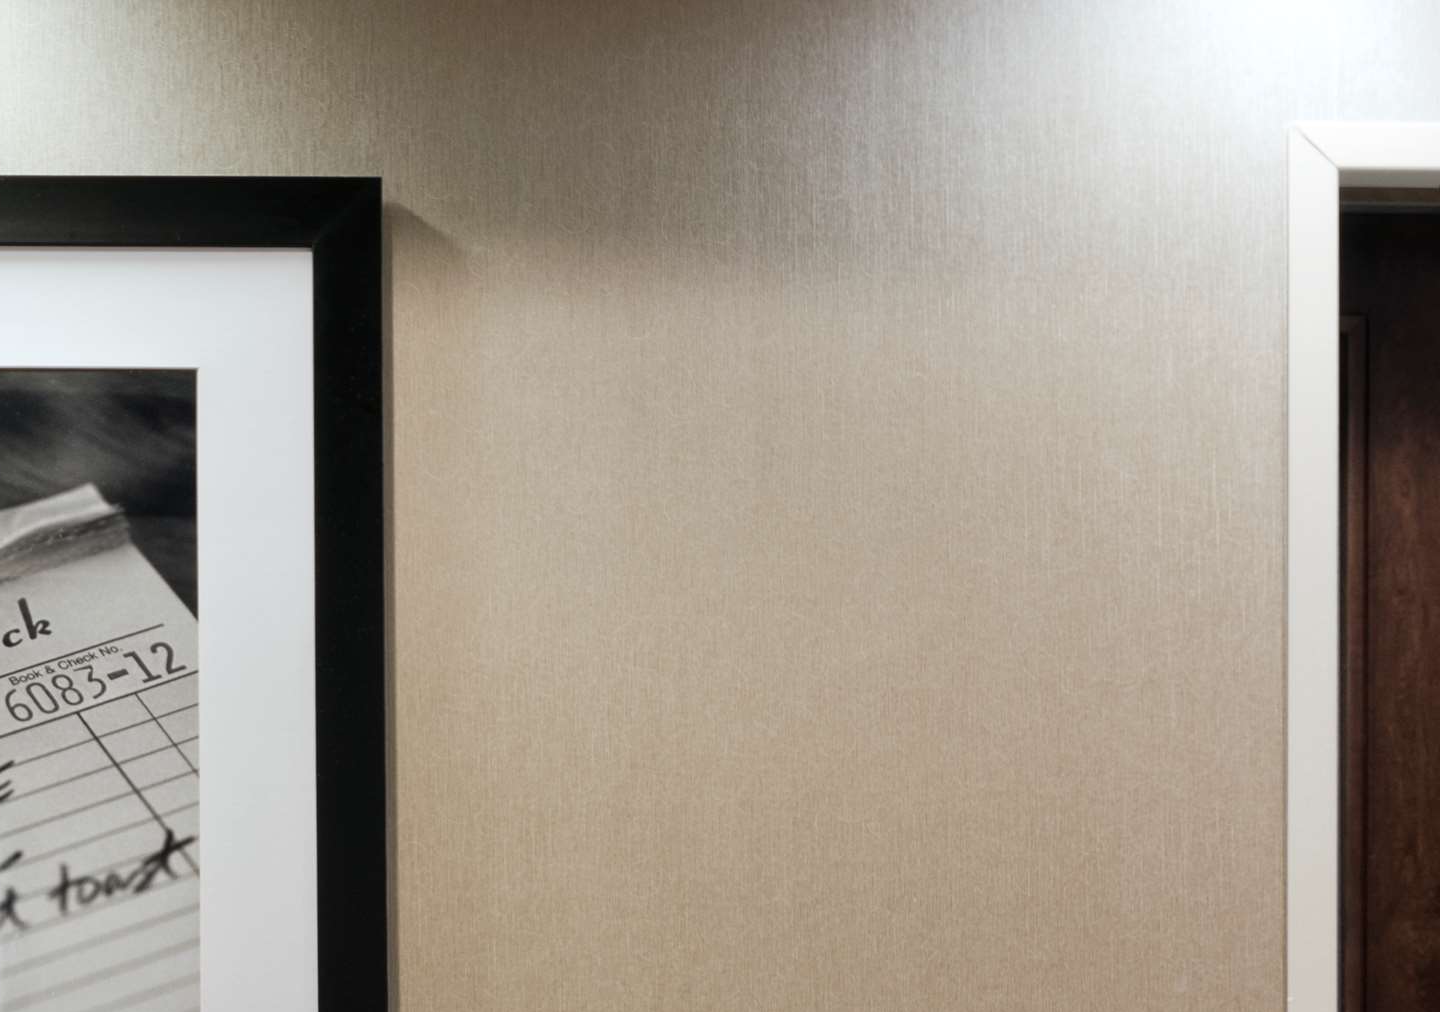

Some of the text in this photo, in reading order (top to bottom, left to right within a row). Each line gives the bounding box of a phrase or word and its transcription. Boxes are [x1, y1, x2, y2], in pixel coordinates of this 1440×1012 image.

[4, 641, 188, 723] 6083-12
[7, 645, 124, 687] Book & Check No.
